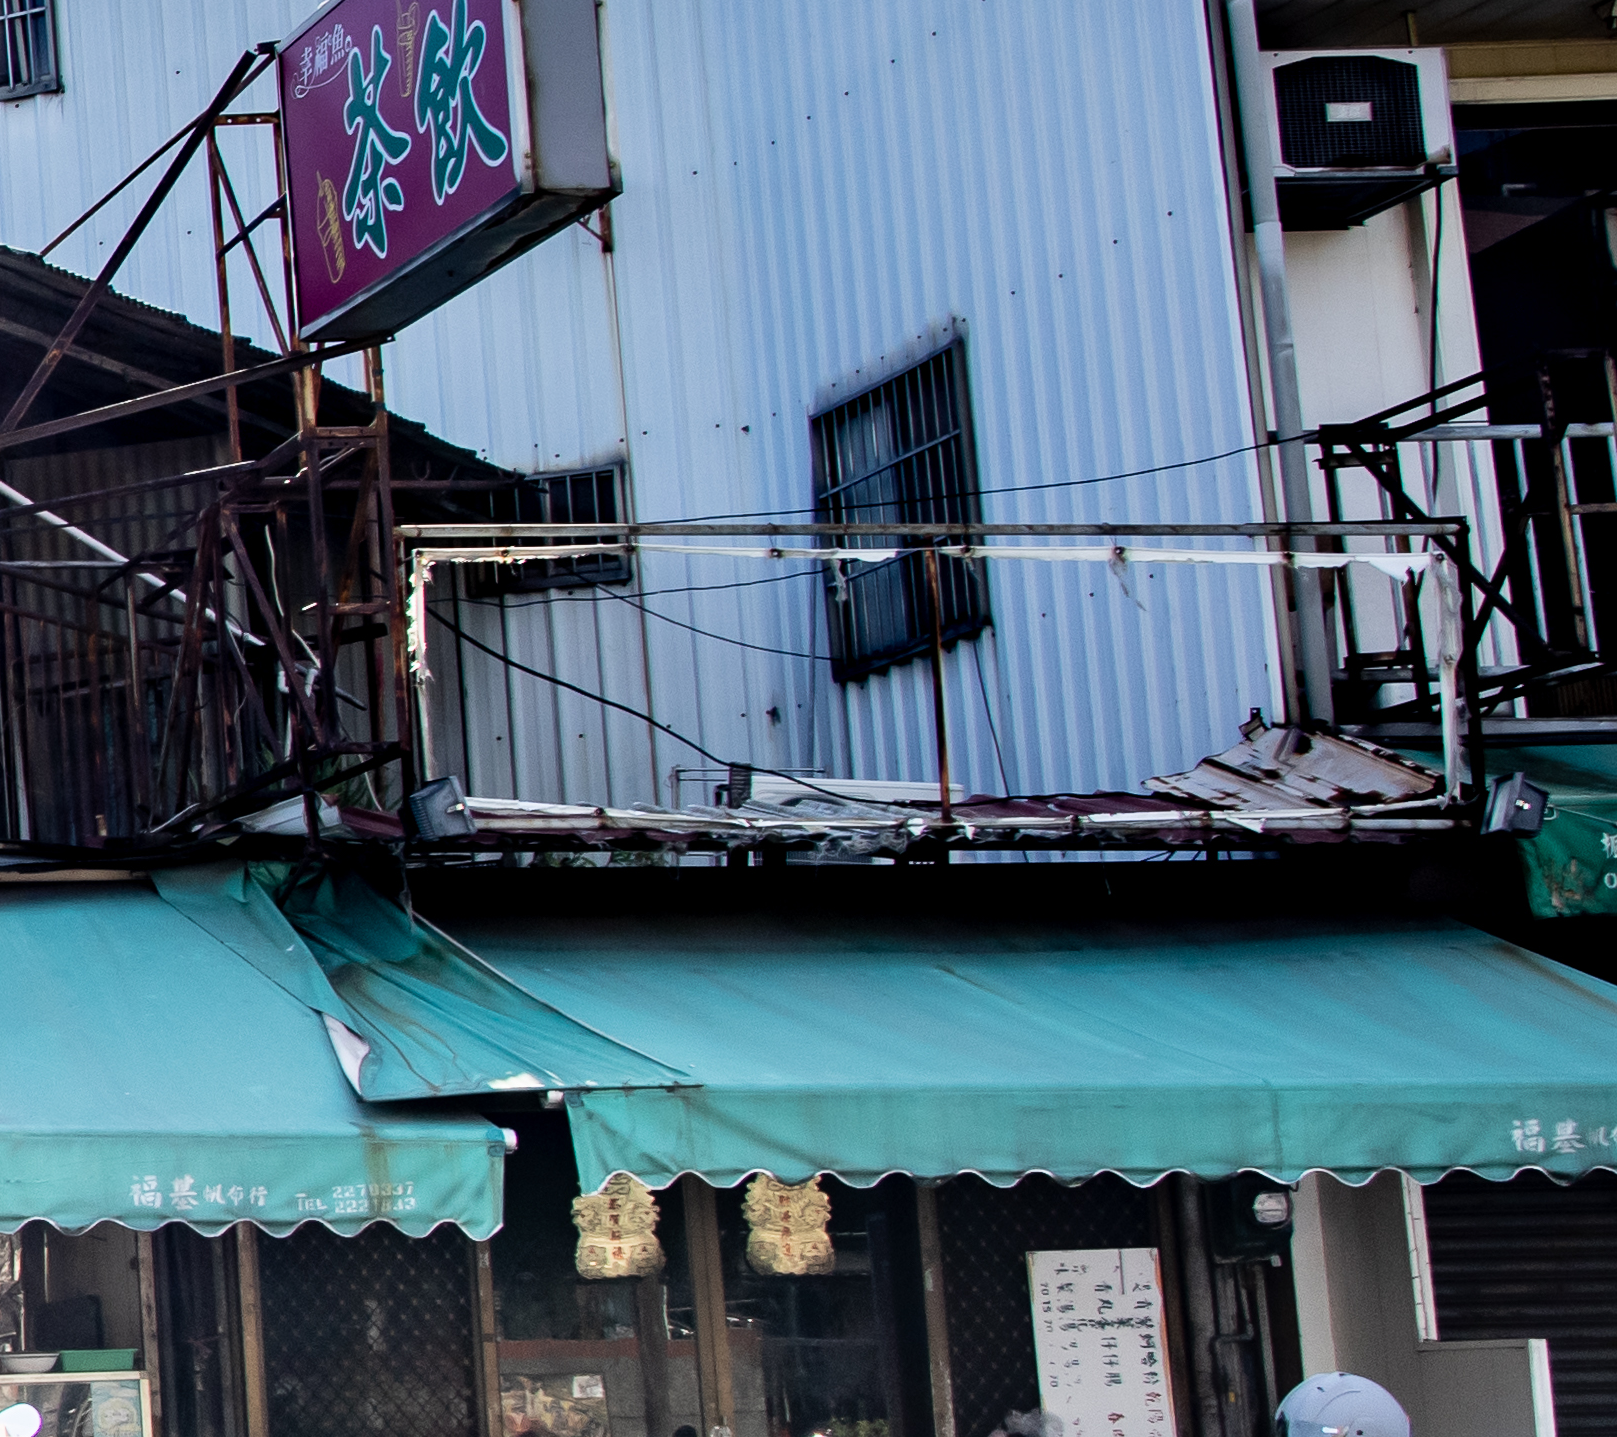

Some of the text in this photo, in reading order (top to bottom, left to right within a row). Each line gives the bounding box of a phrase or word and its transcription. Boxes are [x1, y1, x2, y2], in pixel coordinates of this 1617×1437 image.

[299, 24, 345, 86] 幸福魚
[1511, 1119, 1617, 1154] 福基帆
